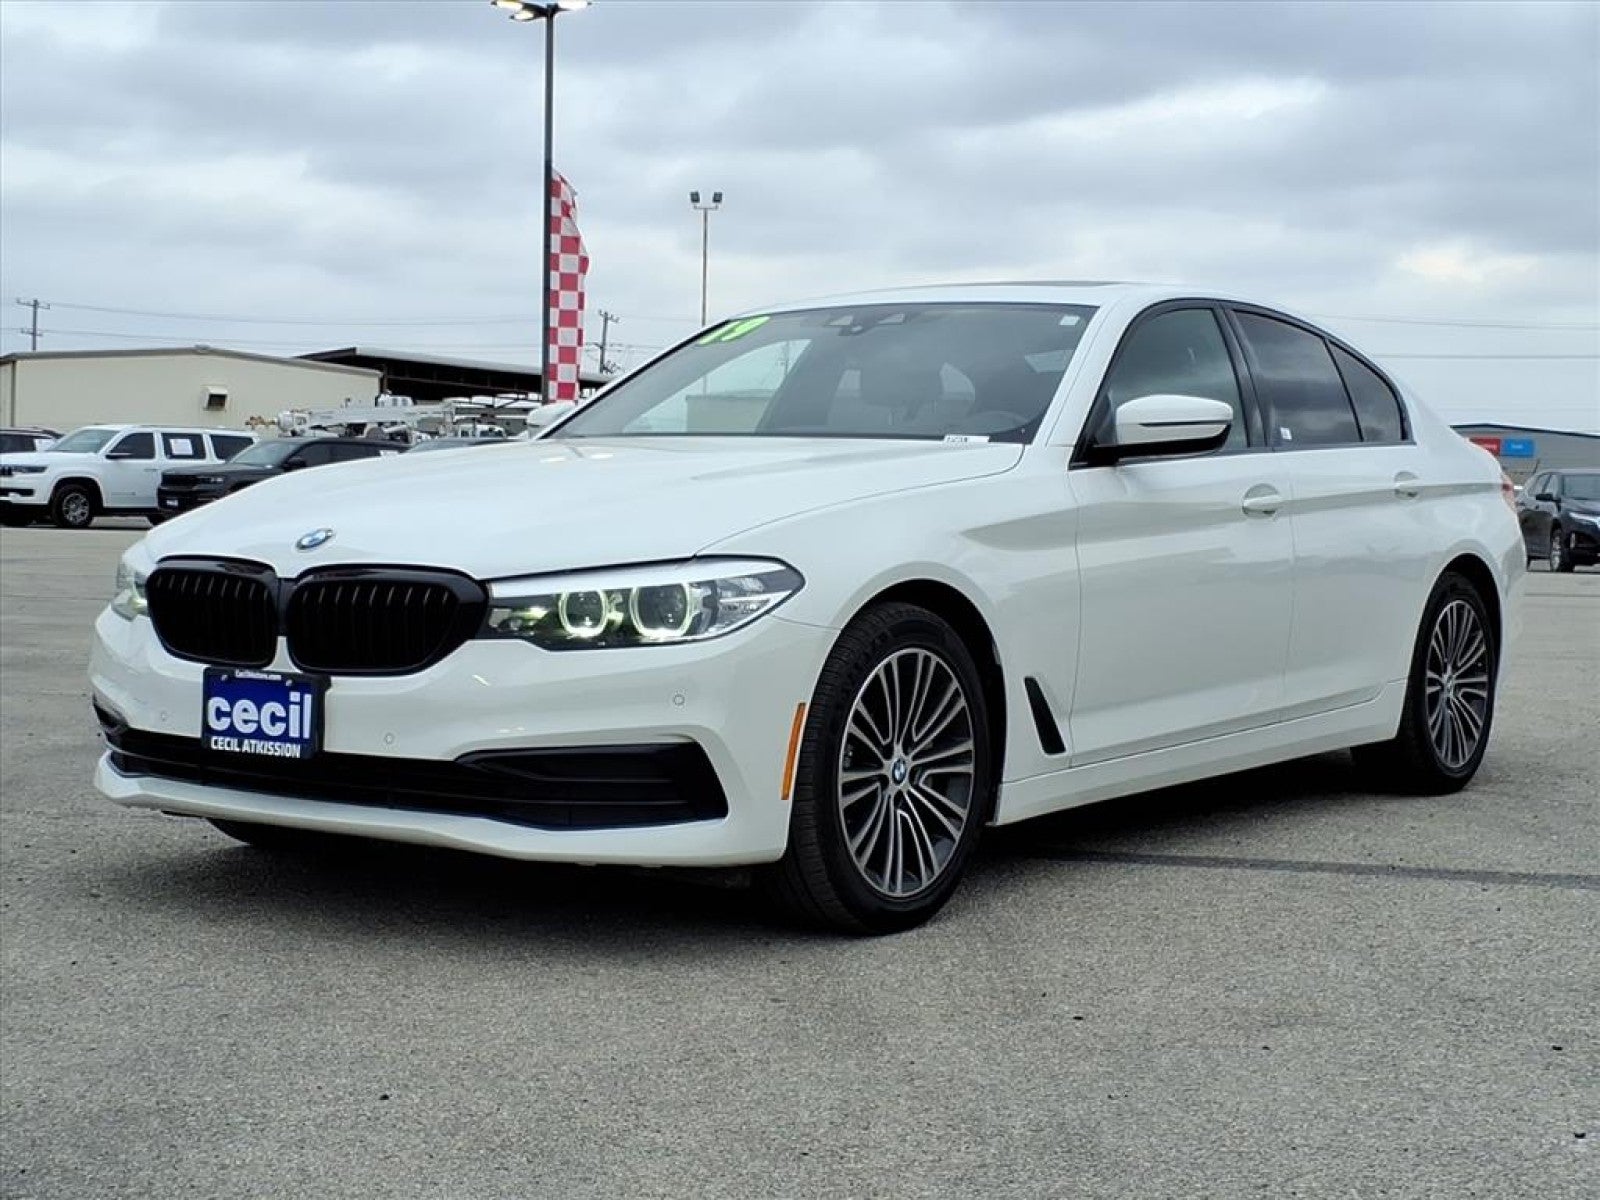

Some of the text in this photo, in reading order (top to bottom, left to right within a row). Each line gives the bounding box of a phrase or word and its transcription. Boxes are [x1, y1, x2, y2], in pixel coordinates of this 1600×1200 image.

[207, 691, 312, 739] cecil
[211, 735, 301, 758] CECIL ATKISSION
